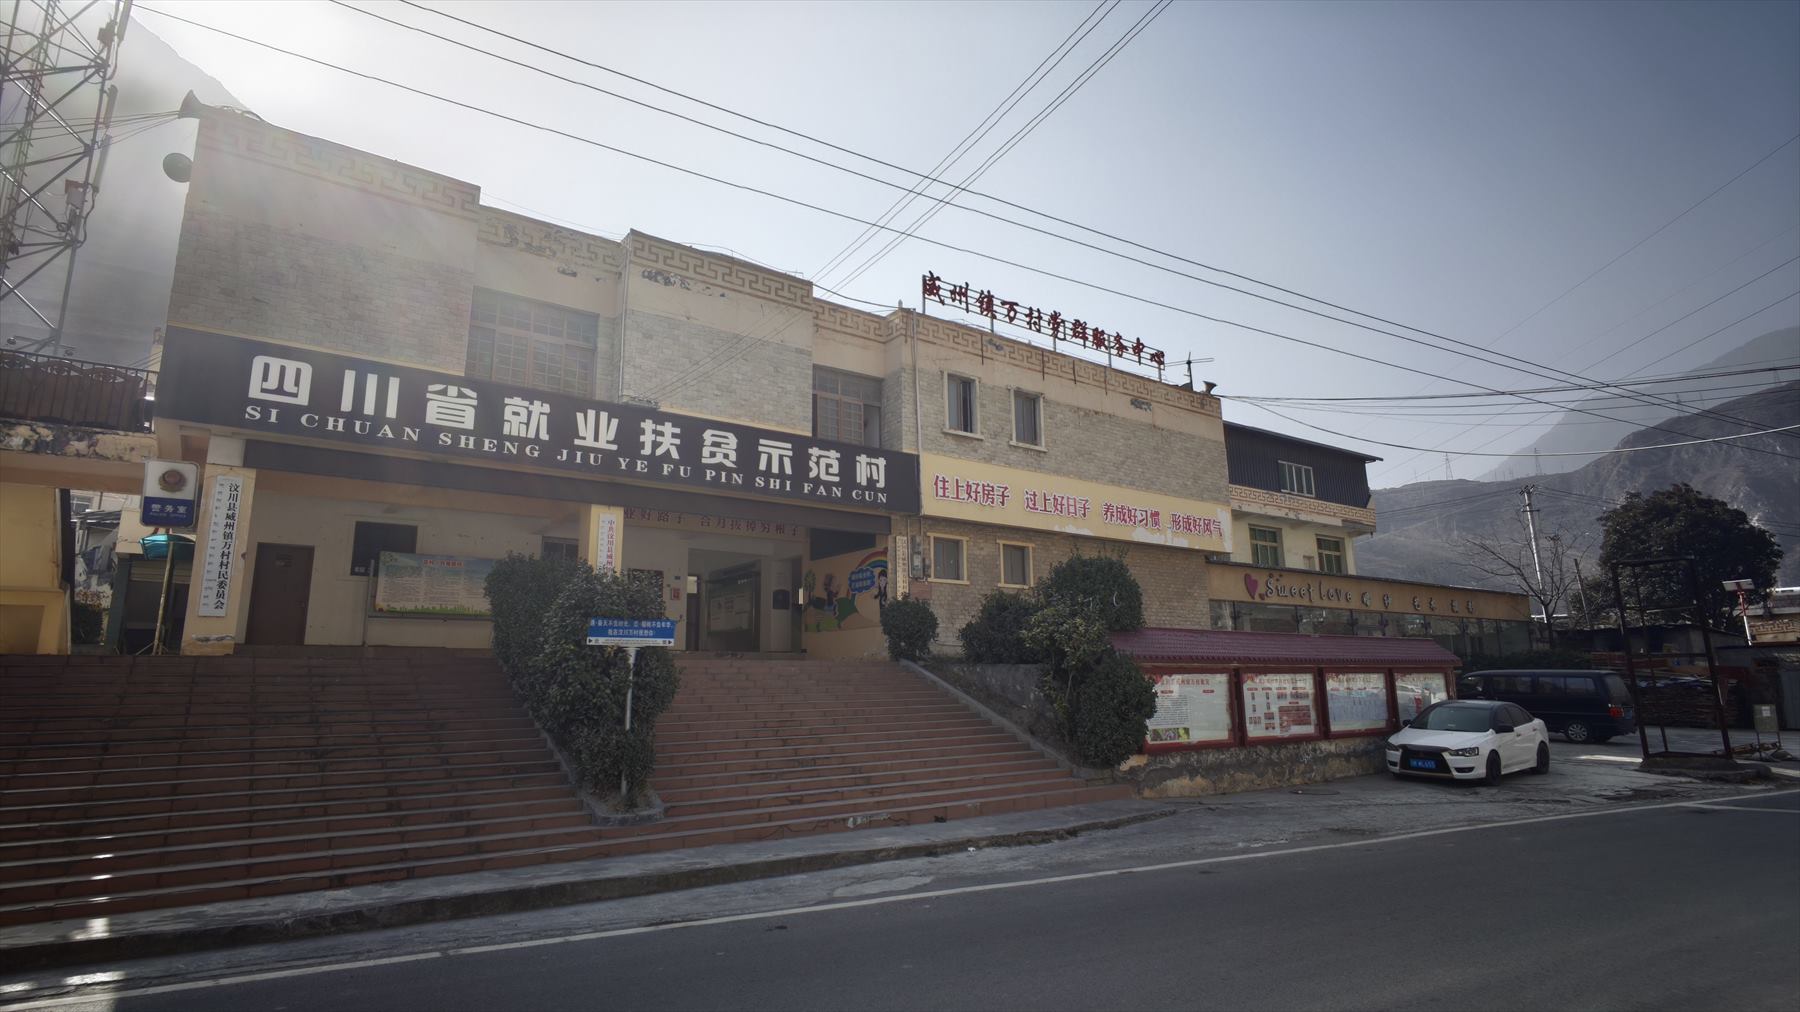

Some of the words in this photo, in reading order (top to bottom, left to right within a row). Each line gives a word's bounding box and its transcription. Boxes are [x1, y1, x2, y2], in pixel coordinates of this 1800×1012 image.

[923, 271, 1165, 367] 威州镇万村党群服务中心
[245, 405, 279, 425] SI
[300, 412, 422, 442] CHUAN
[438, 431, 541, 458] SHENG
[557, 447, 603, 467] JIU
[618, 456, 649, 473] YE
[662, 463, 691, 479] FU
[704, 468, 743, 485] PIN
[755, 475, 791, 492] SHI
[803, 482, 842, 498] FAN
[852, 489, 888, 504] CUN
[248, 355, 888, 489] 四川省就业扶贫示范村
[151, 504, 188, 514] 警务室
[214, 483, 240, 610] 汶川县威州镇万村村民委员会
[933, 474, 1010, 508] 住上好房子
[1024, 489, 1091, 519] 过上好日子
[1102, 502, 1162, 529] 养成好习惯
[1170, 512, 1224, 537] 形成好风气
